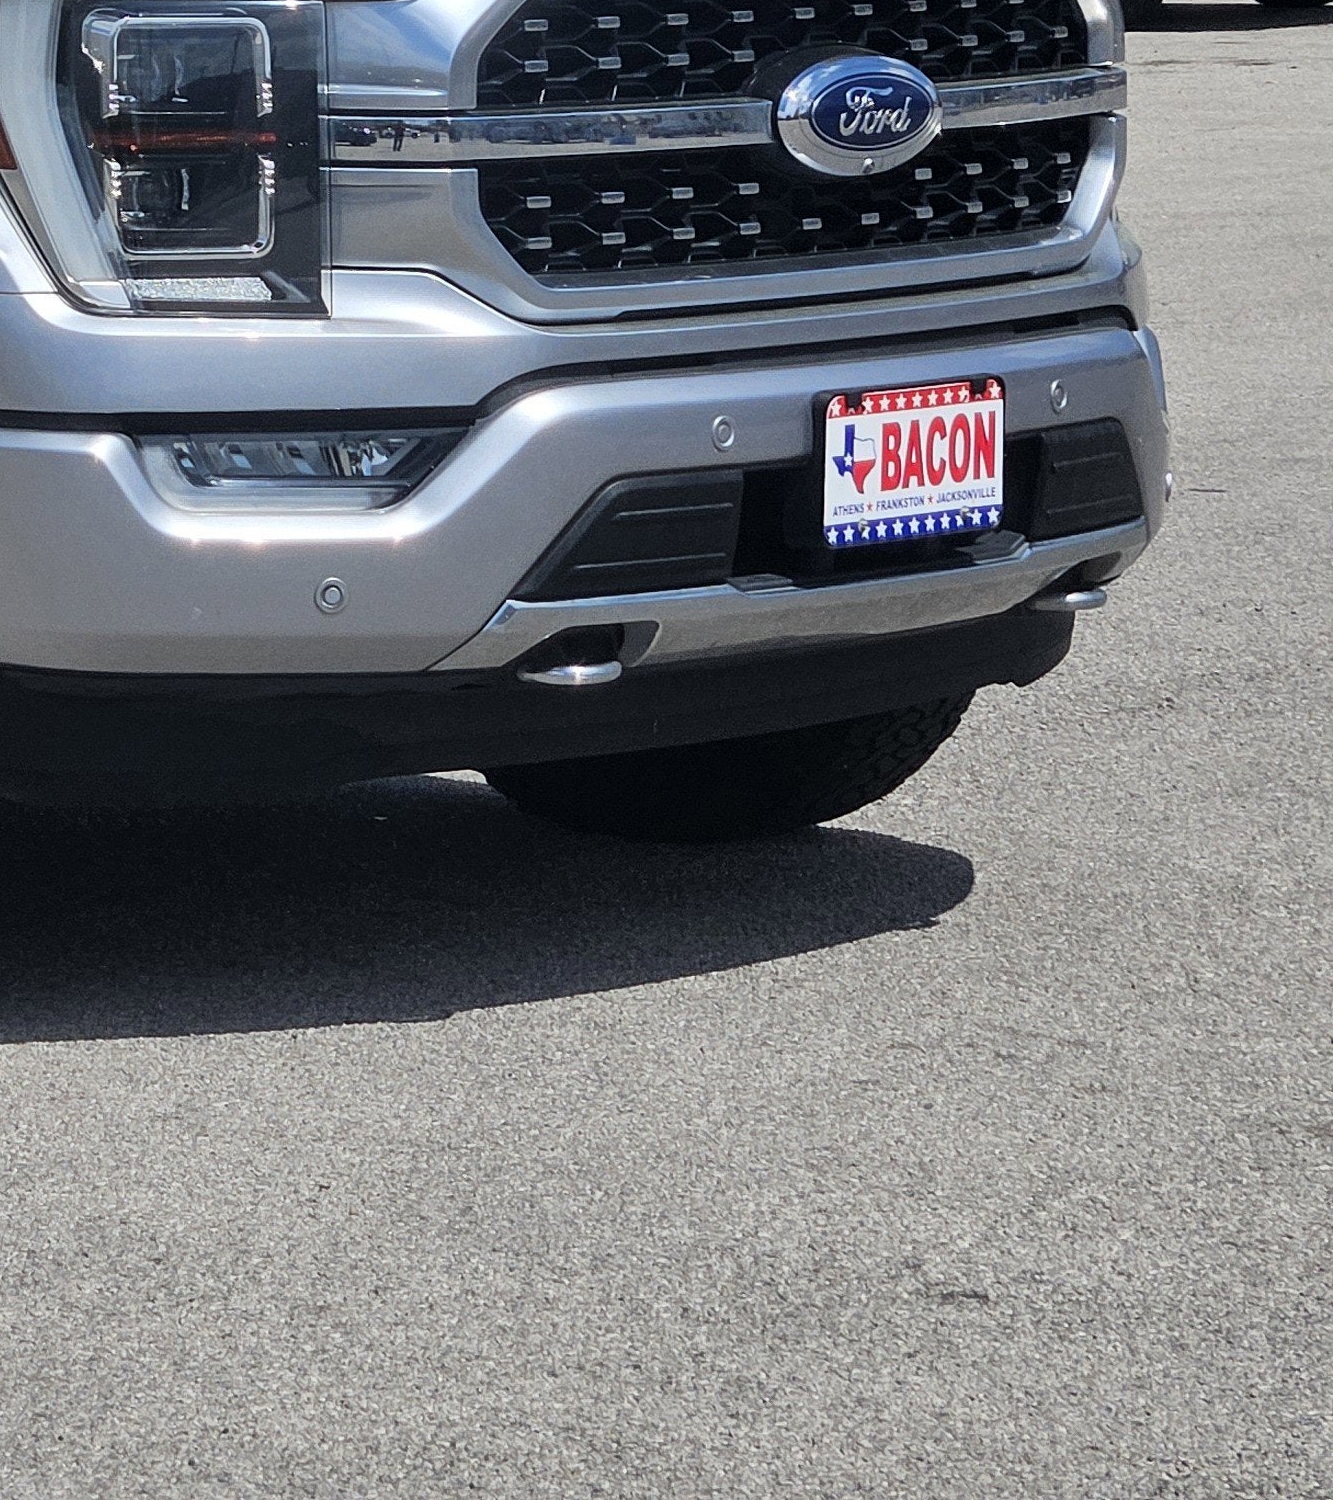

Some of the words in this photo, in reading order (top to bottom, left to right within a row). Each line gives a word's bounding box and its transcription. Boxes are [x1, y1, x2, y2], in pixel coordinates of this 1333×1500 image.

[839, 86, 913, 137] Ford
[880, 410, 997, 492] BACON
[832, 501, 866, 518] ATHENS
[875, 494, 926, 513] FRANKSTON
[935, 486, 997, 505] JACKSONVILLE
